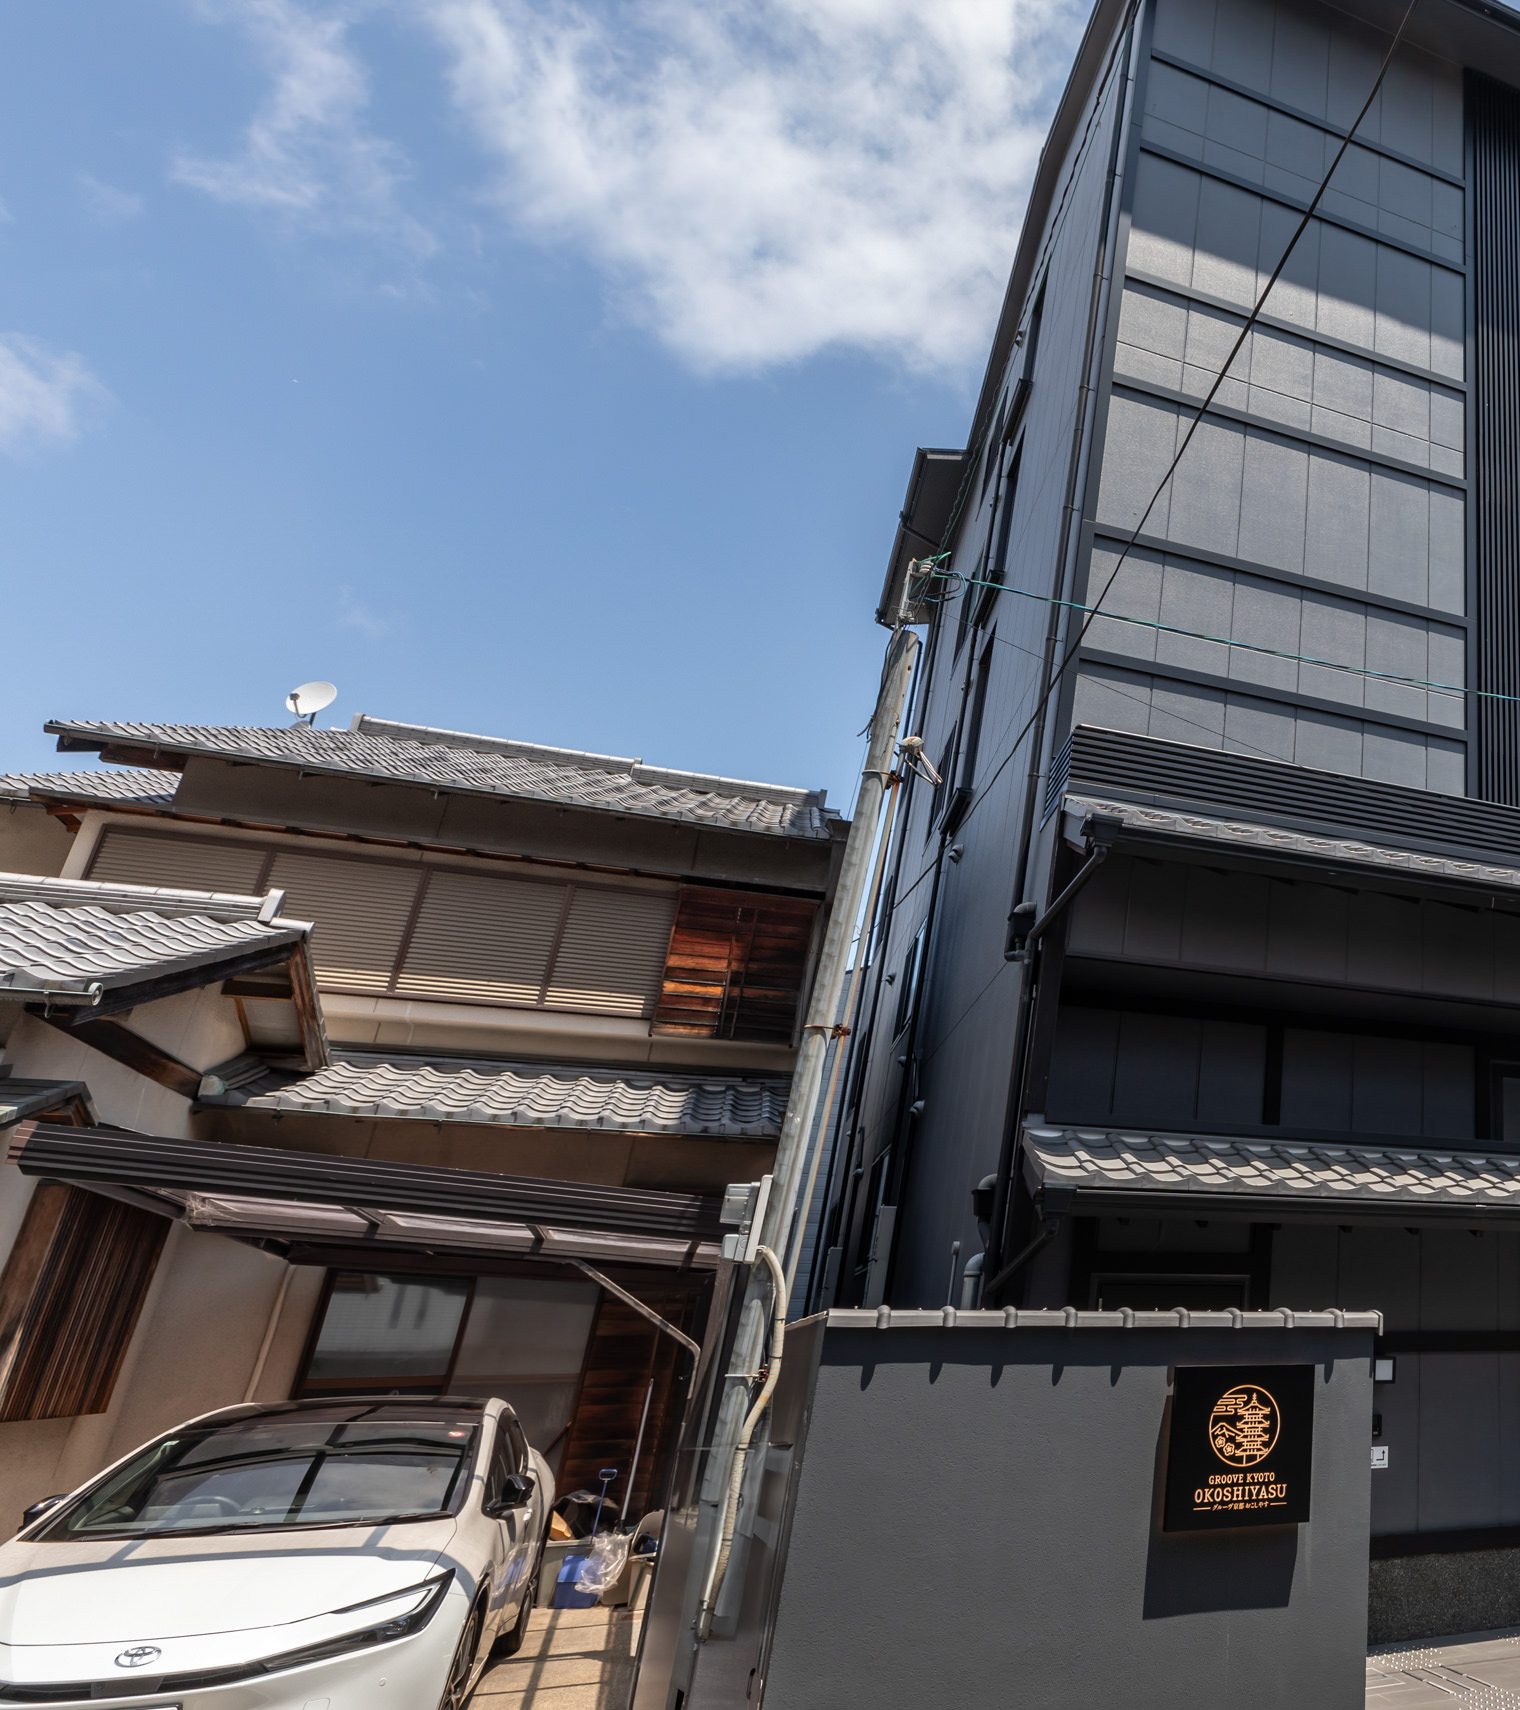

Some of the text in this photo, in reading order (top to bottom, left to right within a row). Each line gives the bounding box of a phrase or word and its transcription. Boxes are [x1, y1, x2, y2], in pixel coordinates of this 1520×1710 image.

[1208, 1472, 1275, 1485] GROOVE KYOTO
[1194, 1484, 1287, 1503] OKOSHIYASU
